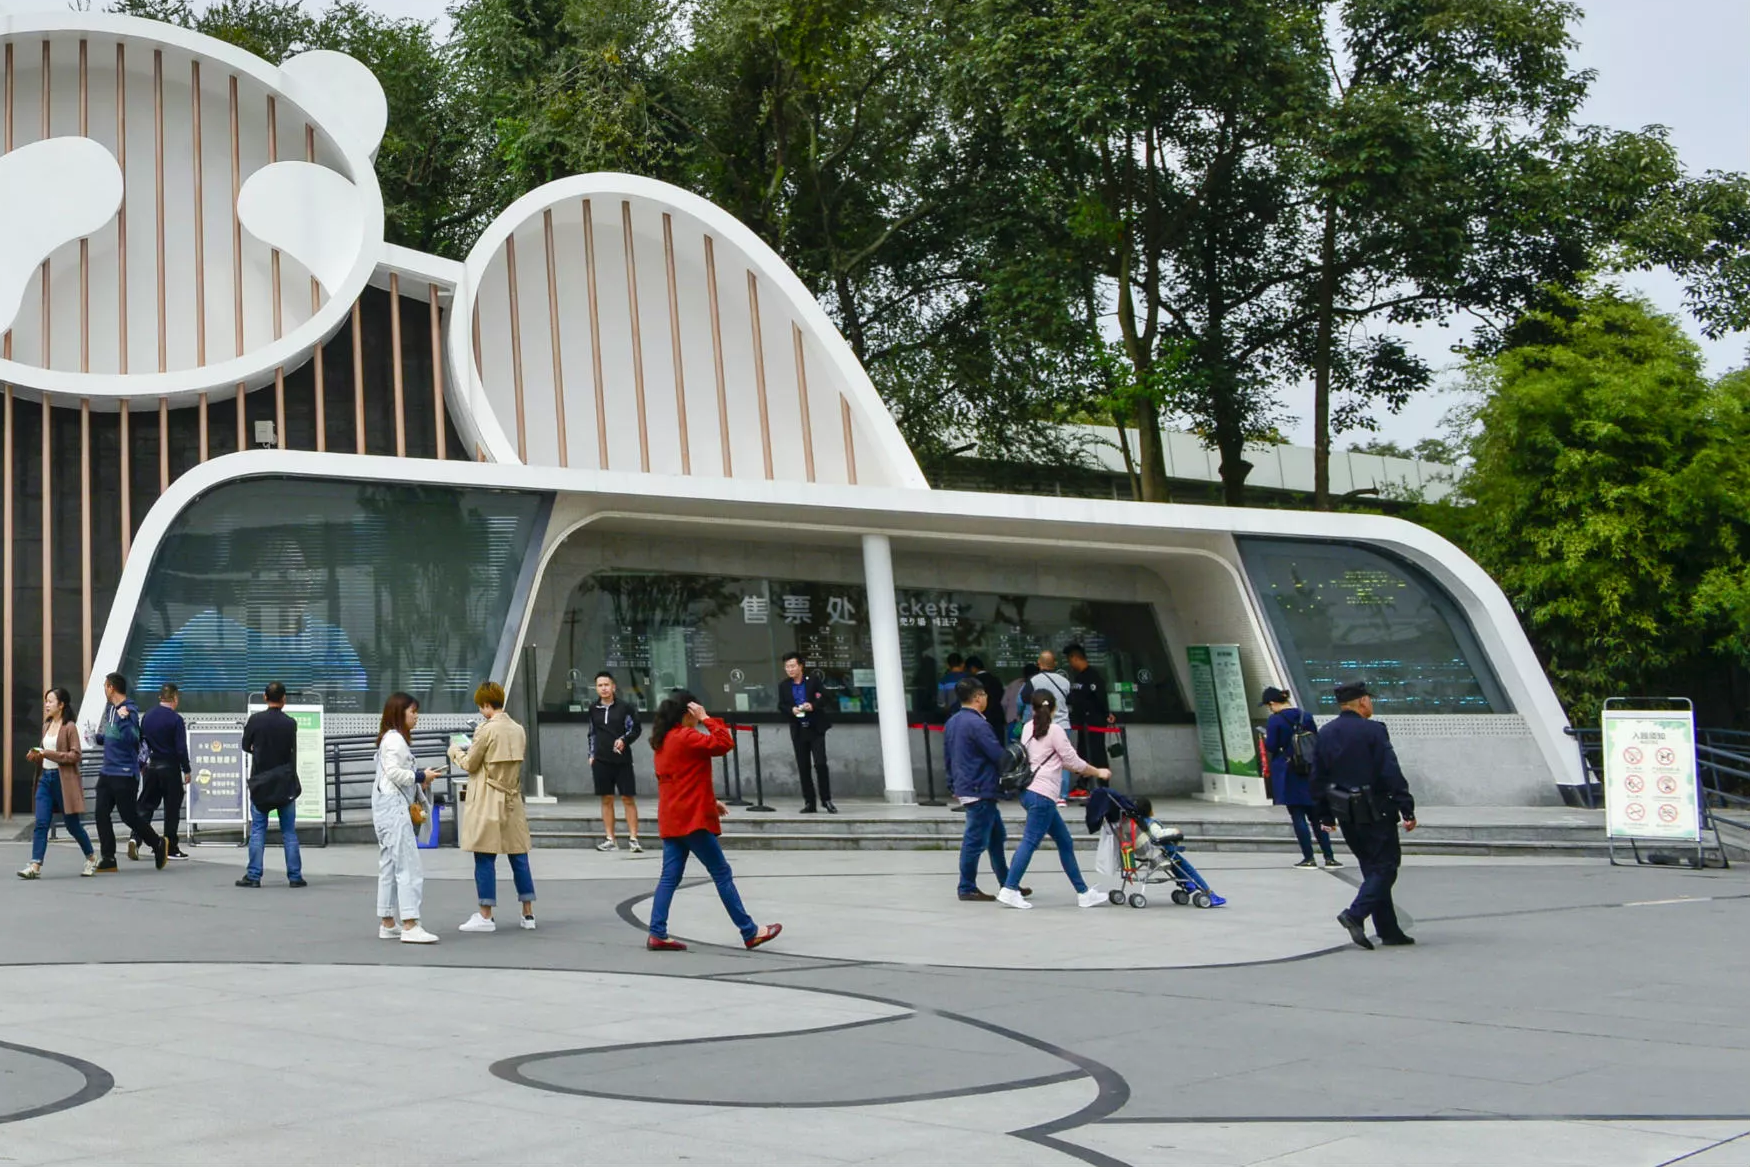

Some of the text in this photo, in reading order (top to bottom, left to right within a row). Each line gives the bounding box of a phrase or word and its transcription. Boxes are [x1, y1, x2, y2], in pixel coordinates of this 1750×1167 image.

[740, 595, 856, 624] 售票处
[899, 598, 959, 616] ckets
